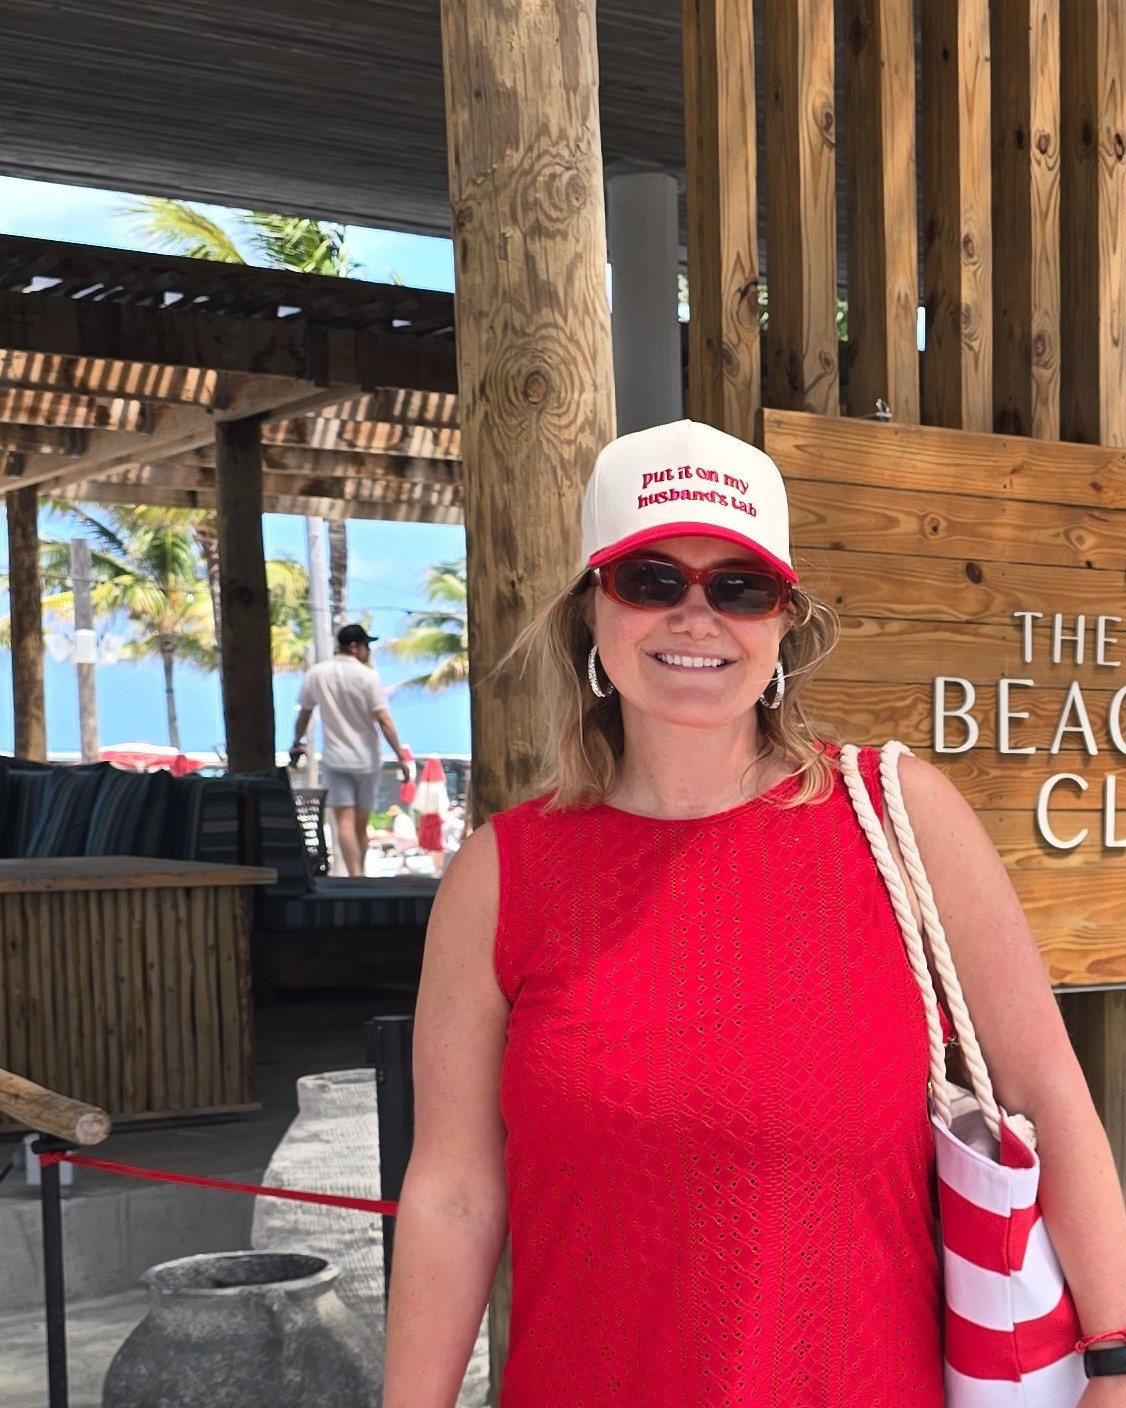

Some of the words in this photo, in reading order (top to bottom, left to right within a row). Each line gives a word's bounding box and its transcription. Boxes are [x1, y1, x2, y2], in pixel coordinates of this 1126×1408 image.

[642, 467, 674, 490] put
[677, 465, 693, 480] it
[695, 467, 719, 483] on
[723, 473, 749, 495] my
[637, 487, 729, 510] husband's
[731, 495, 757, 518] tab
[1013, 611, 1122, 667] THE
